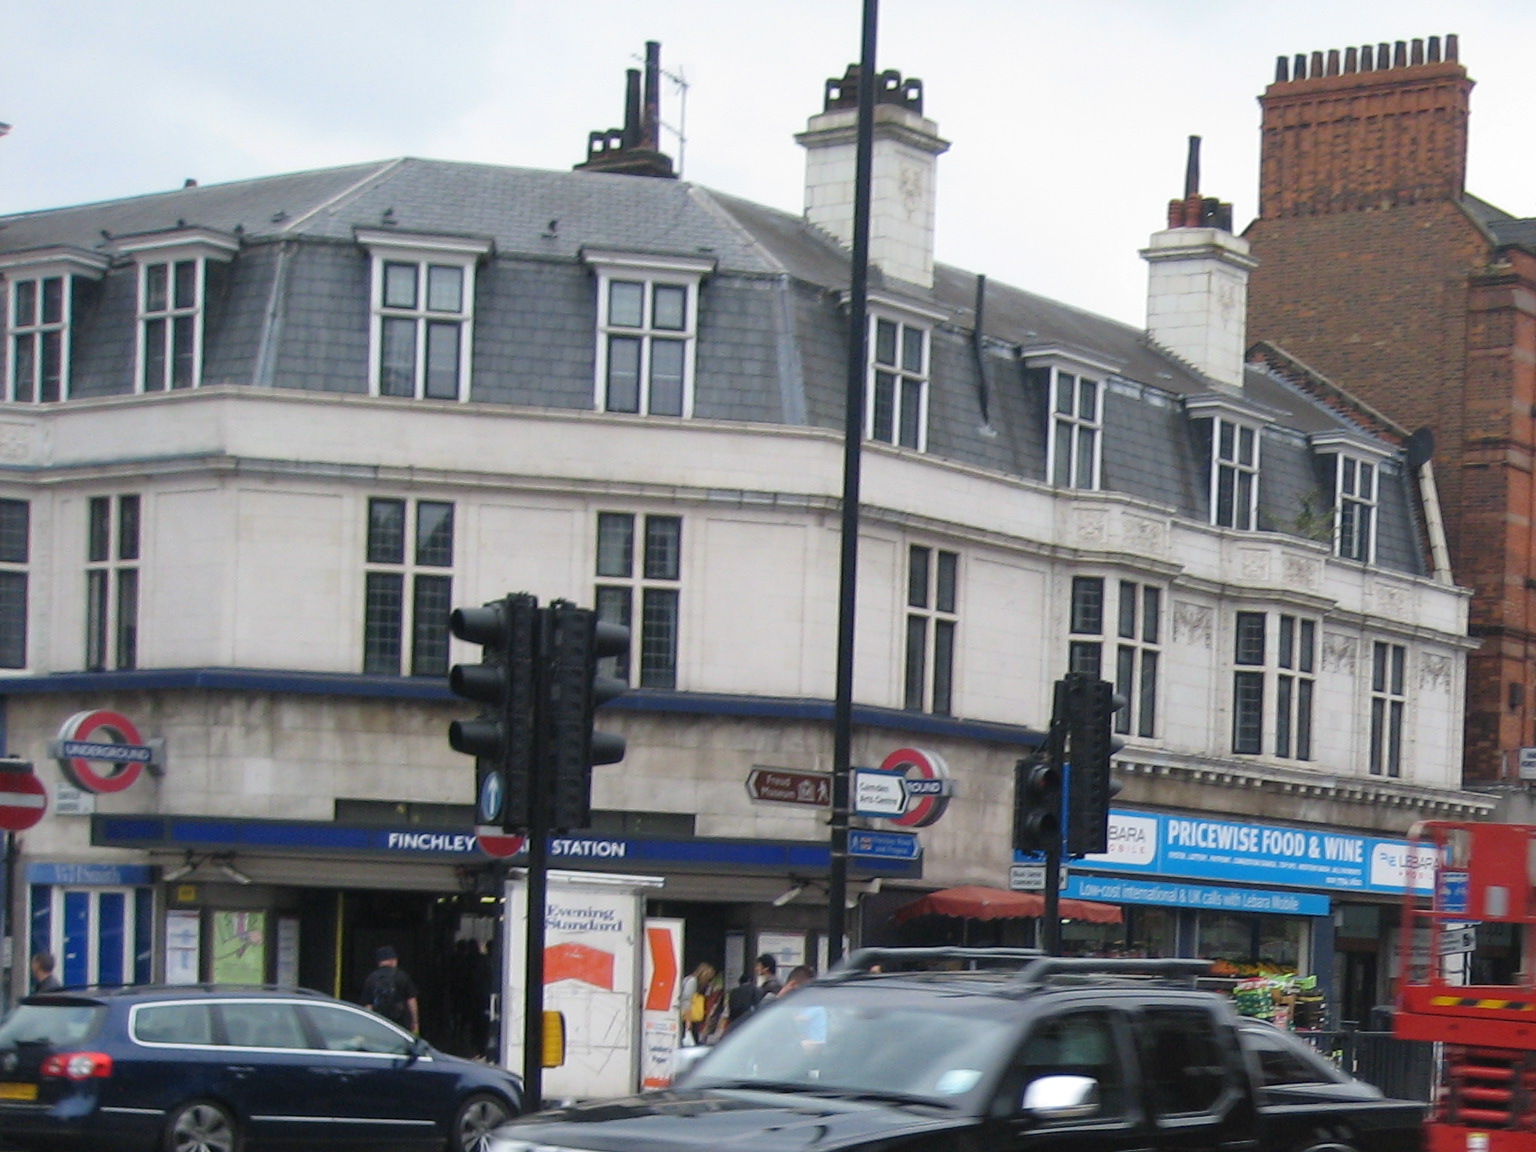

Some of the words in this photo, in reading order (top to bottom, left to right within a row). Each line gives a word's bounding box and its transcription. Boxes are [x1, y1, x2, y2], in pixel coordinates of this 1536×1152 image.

[68, 744, 149, 760] UNDERGROUND
[1109, 825, 1145, 843] BARA
[1167, 820, 1259, 853] PRICEWISE
[1262, 830, 1305, 857] FOOD
[1309, 836, 1321, 859] &
[1324, 837, 1364, 863] WINE
[388, 833, 477, 851] FINCHLEY
[551, 839, 626, 857] STATION
[1079, 882, 1121, 897] Low-cost
[1122, 884, 1178, 900] international
[1203, 891, 1222, 905] calls
[1223, 893, 1241, 906] with
[1243, 894, 1271, 908] Lebara
[1272, 896, 1299, 910] Mobile
[547, 904, 615, 921] Evening
[545, 920, 623, 932] Standard
